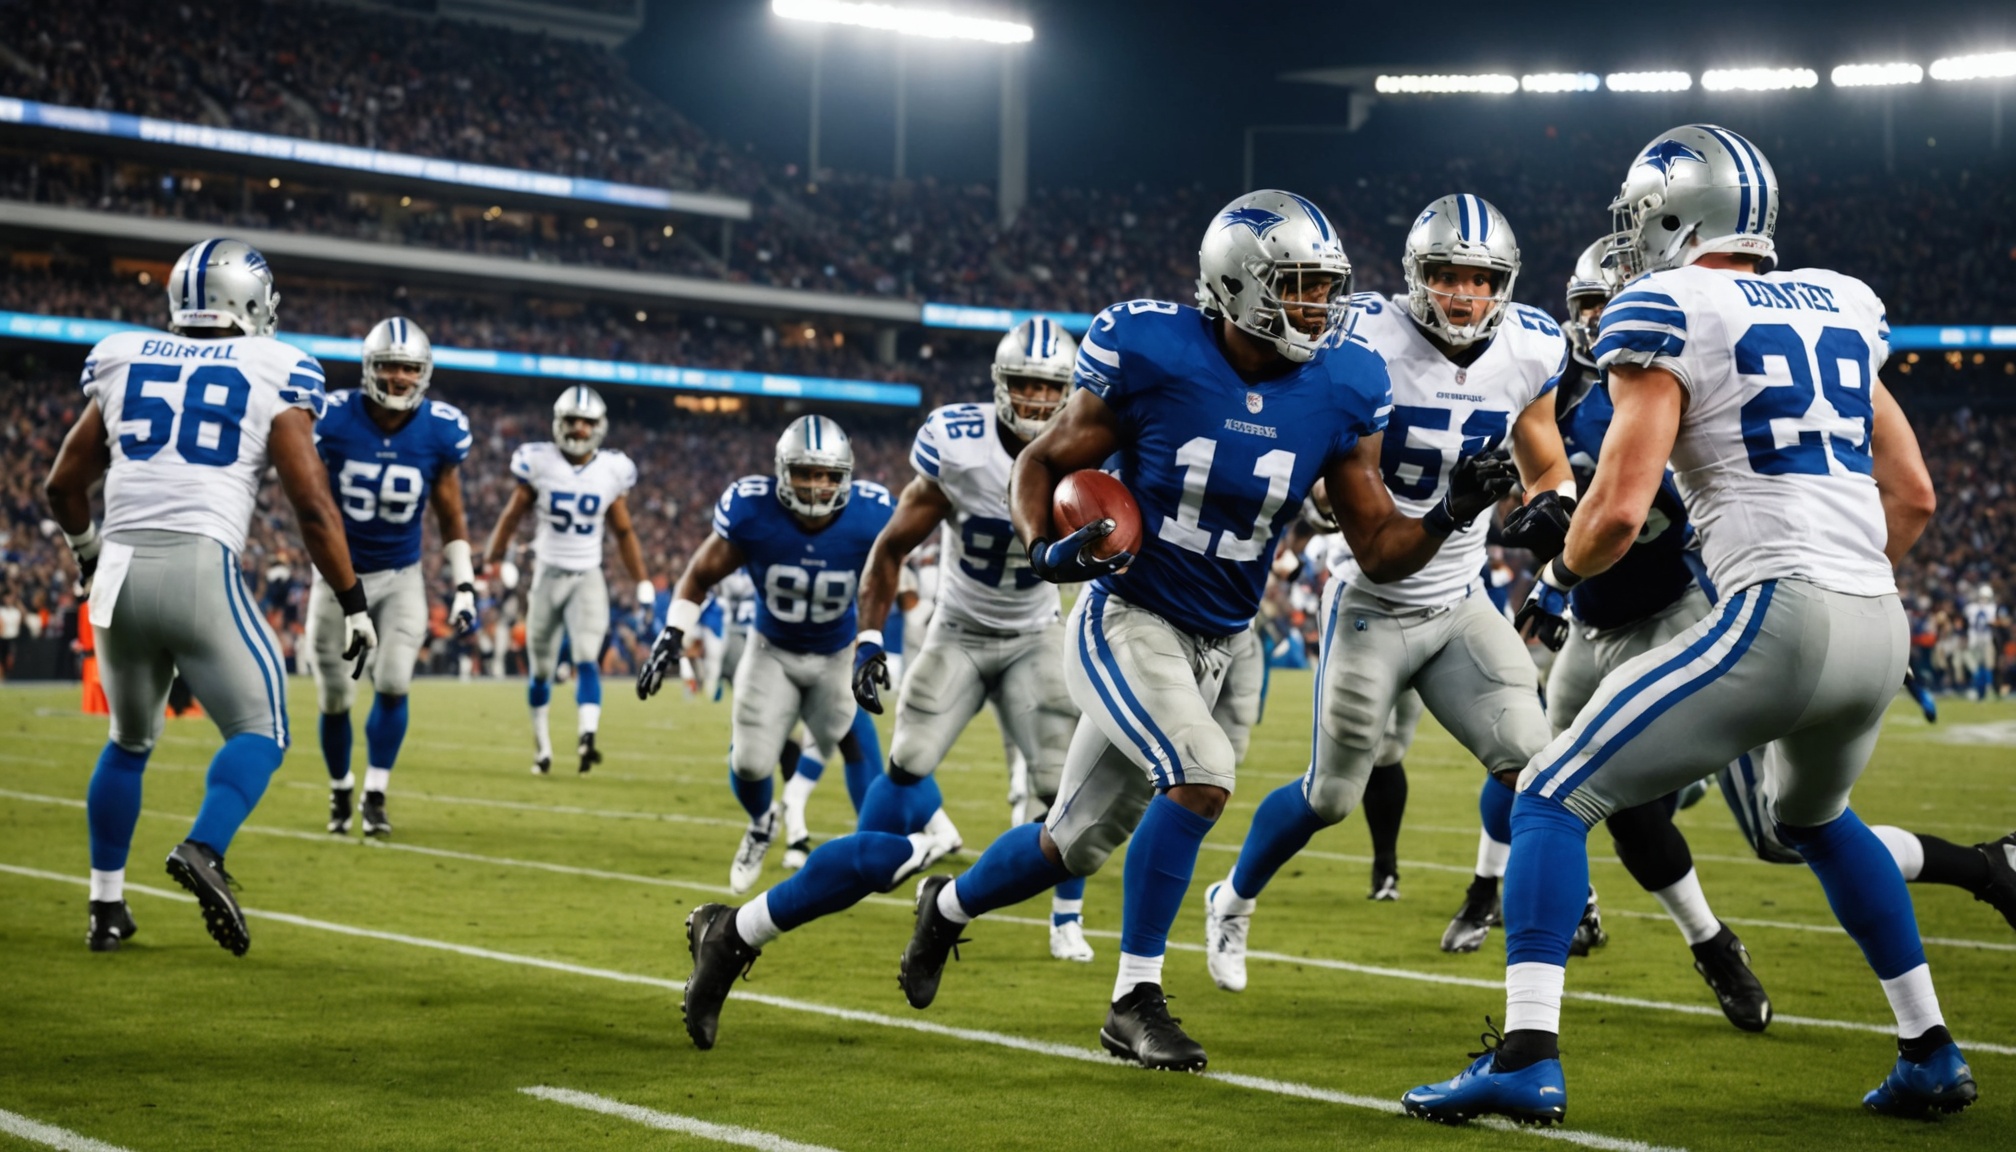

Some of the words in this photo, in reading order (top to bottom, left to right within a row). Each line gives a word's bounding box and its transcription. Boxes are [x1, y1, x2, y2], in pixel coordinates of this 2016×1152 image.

[119, 363, 251, 467] 58
[1734, 323, 1874, 476] 29
[959, 514, 1048, 591] 9
